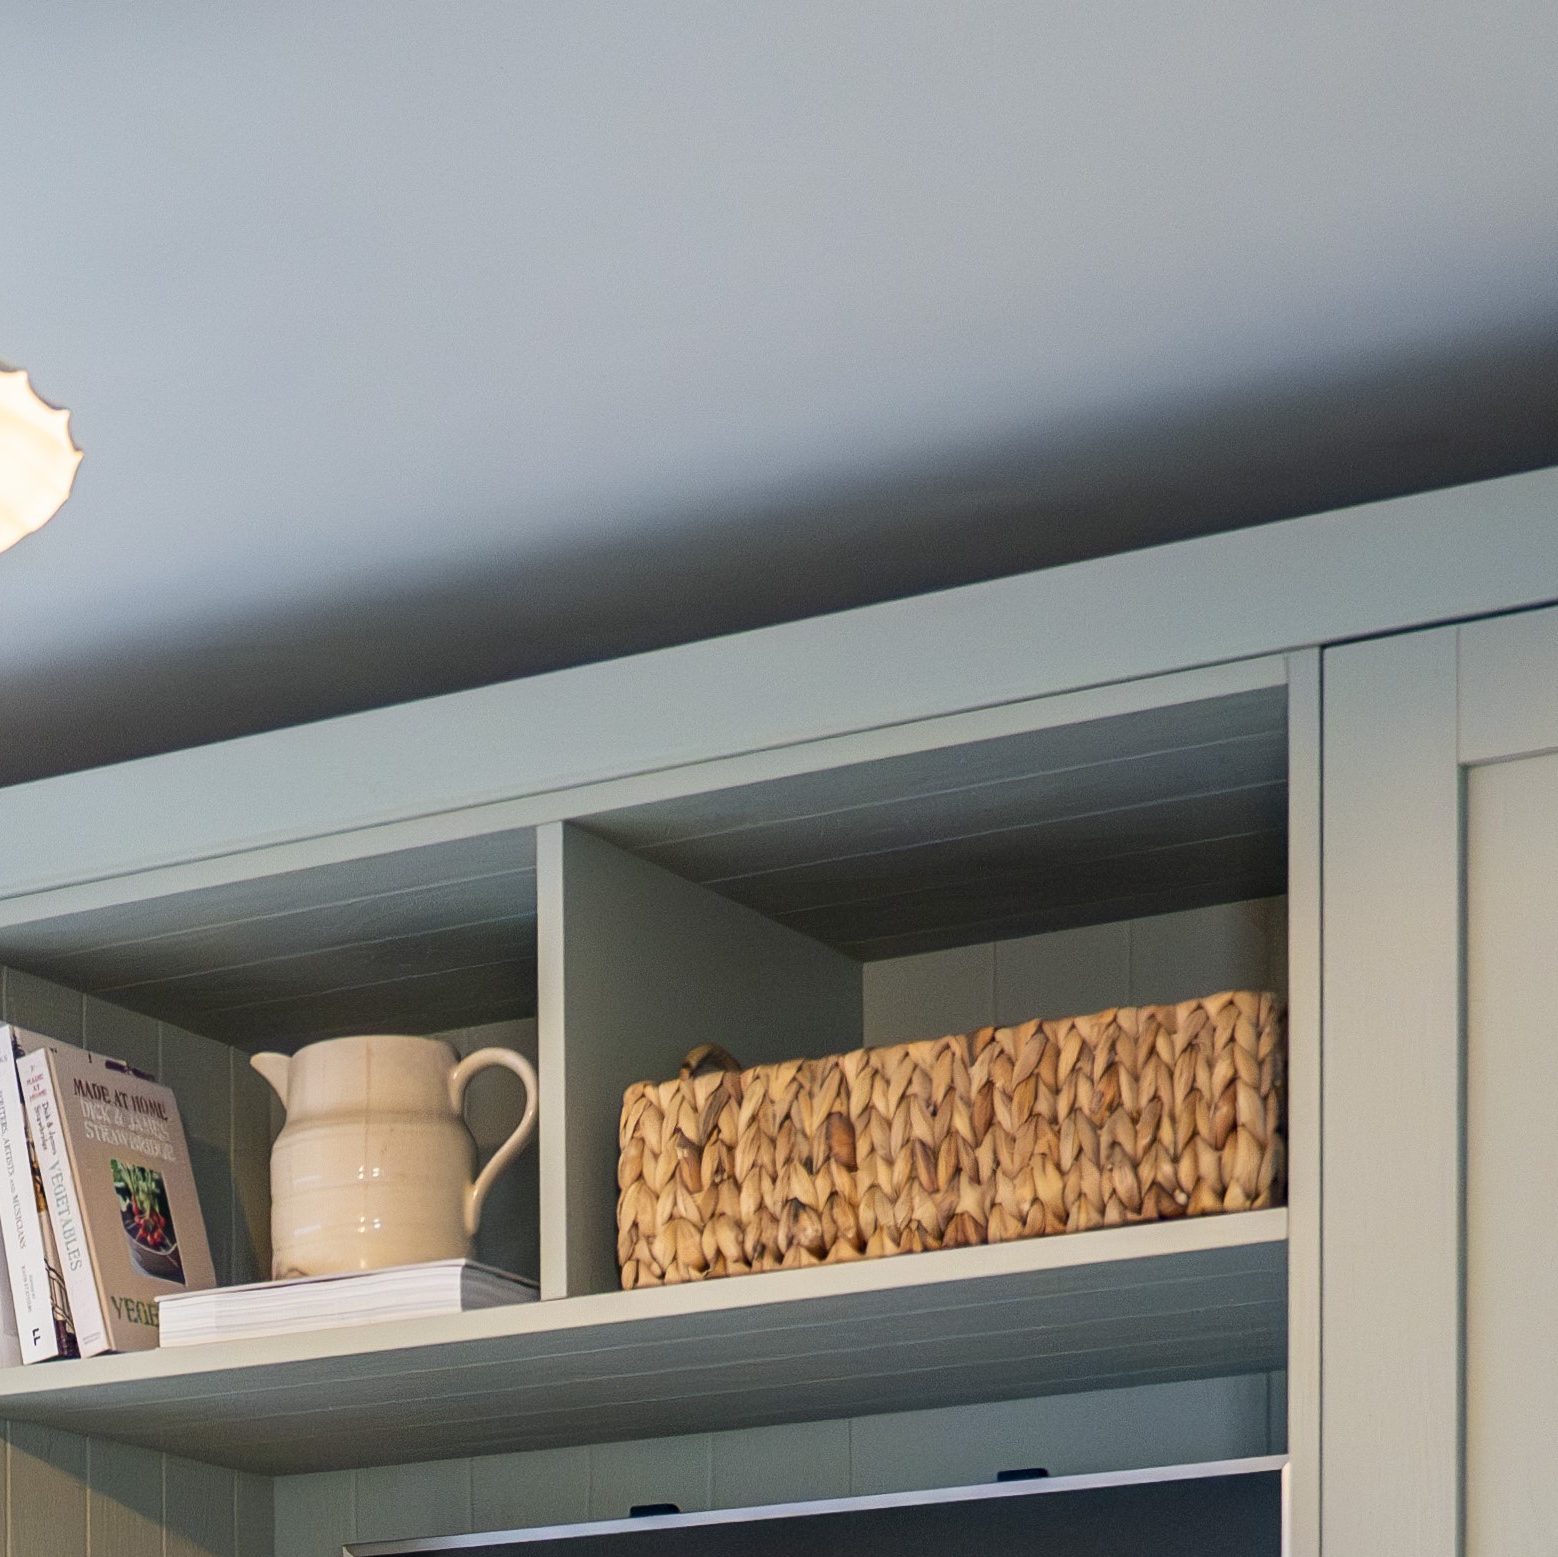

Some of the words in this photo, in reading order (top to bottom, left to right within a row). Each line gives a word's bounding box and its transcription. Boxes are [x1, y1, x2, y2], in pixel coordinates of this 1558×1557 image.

[73, 1078, 111, 1104] MADE
[114, 1089, 129, 1110] AT
[131, 1095, 169, 1121] HOME
[79, 1099, 112, 1124] DICK
[114, 1106, 124, 1127] &
[128, 1112, 170, 1141] JAMES
[13, 1194, 27, 1250] MUSICIANS
[48, 1160, 83, 1272] VEGETABLES
